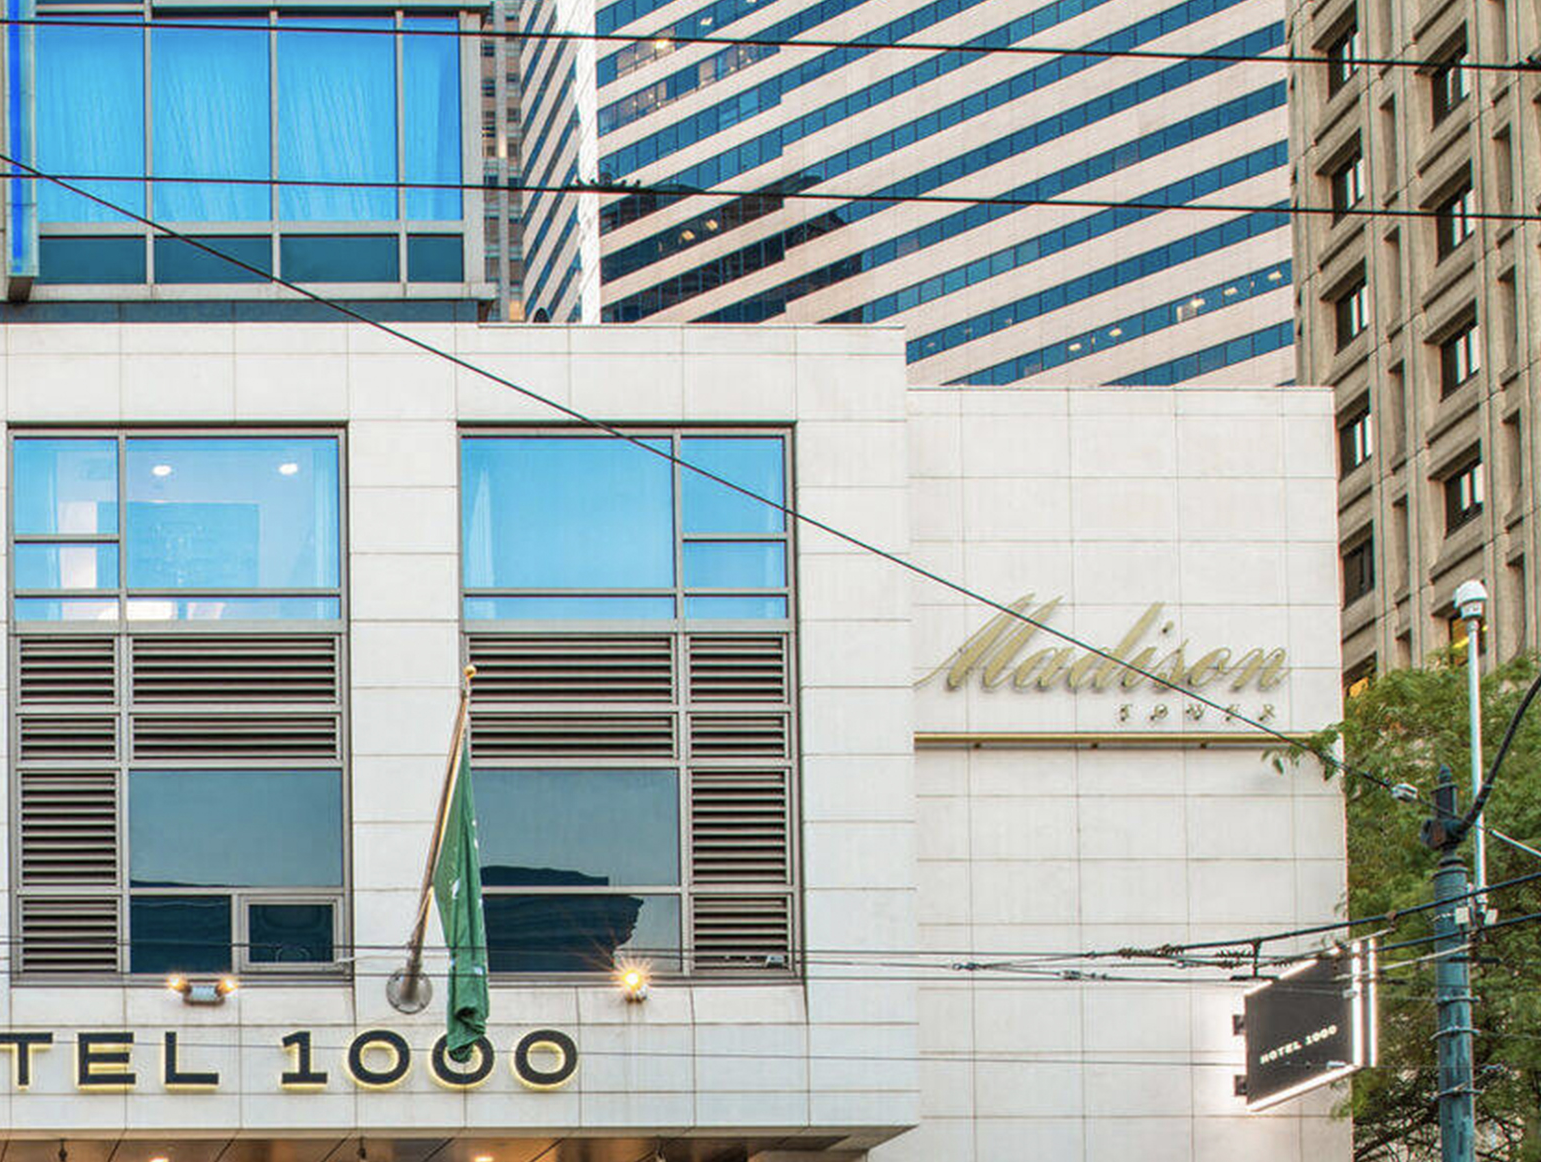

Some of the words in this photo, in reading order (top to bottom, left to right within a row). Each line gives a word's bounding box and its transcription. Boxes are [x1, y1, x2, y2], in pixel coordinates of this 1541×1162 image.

[913, 592, 1291, 692] Madison
[1119, 703, 1276, 722] TOWER
[280, 1030, 579, 1088] 1000
[1260, 1041, 1302, 1064] HOTEL
[1305, 1024, 1338, 1046] 1000
